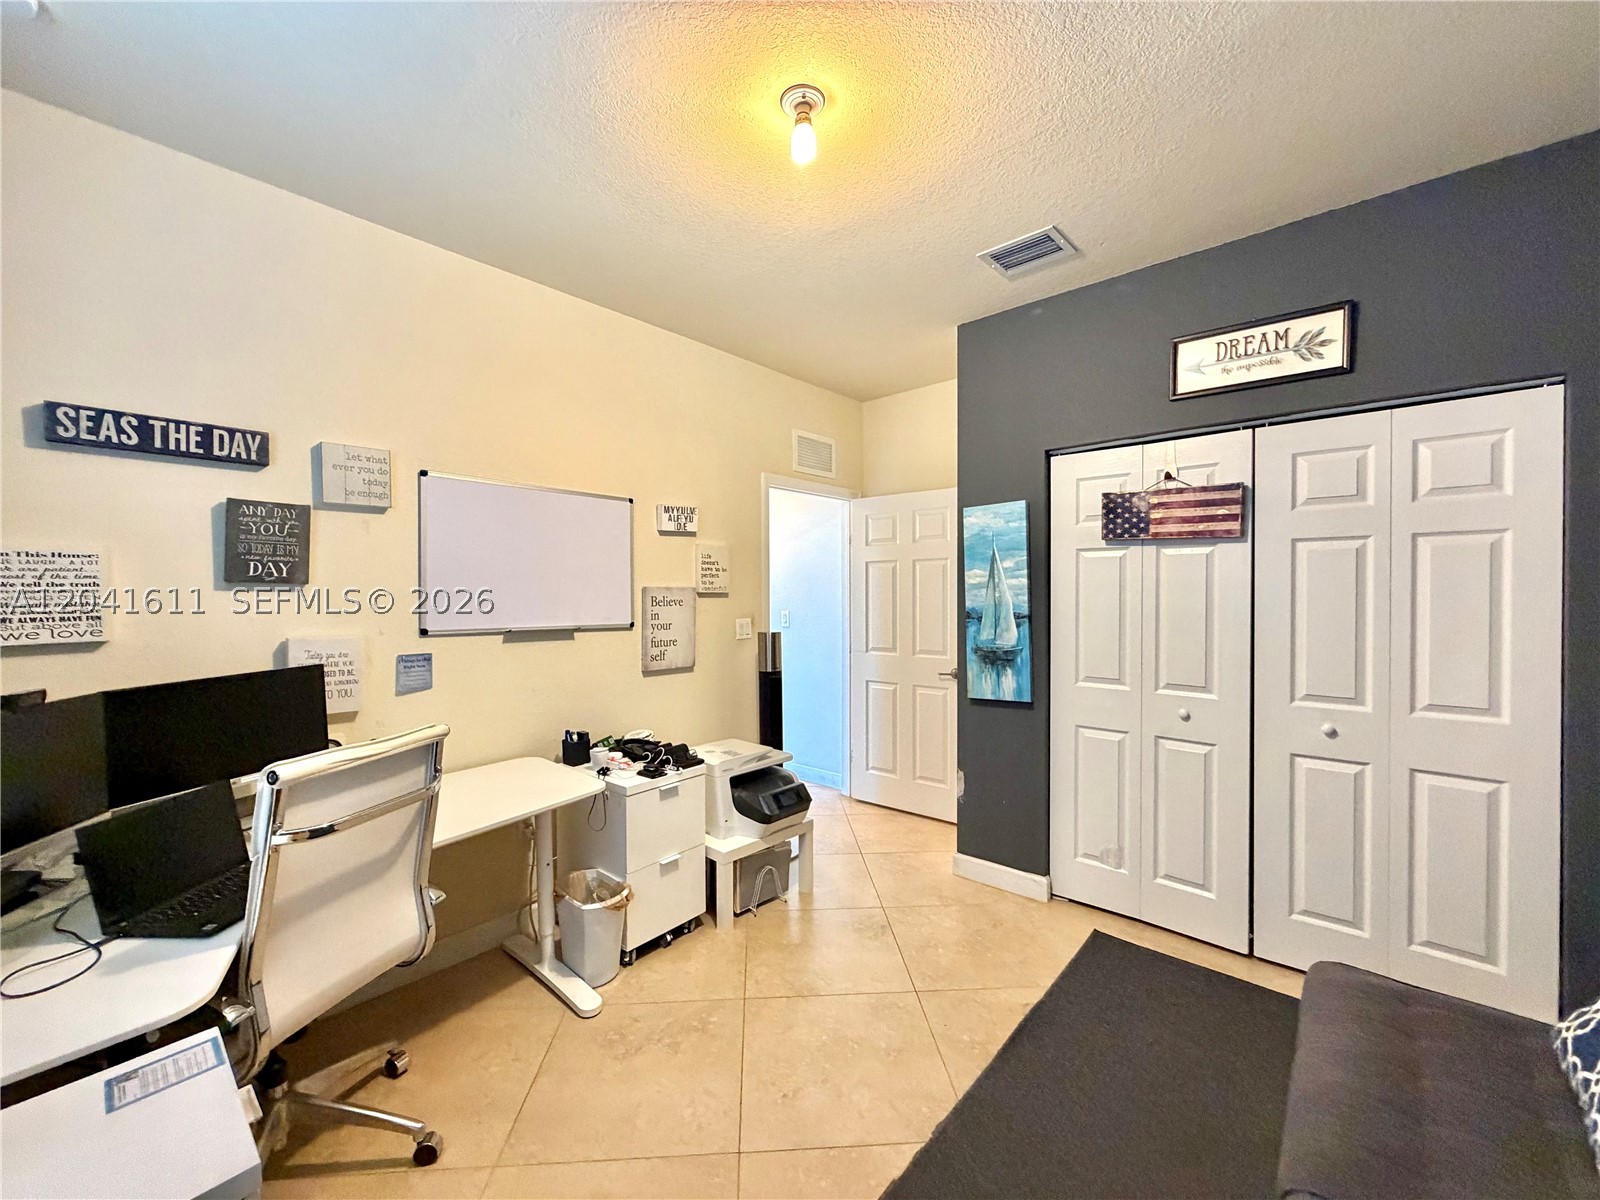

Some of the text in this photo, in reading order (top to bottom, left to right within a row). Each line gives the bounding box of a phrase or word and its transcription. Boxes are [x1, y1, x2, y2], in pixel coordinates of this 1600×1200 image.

[1215, 327, 1291, 362] DREAM
[55, 406, 262, 461] SEAS THE DAY
[345, 452, 388, 464] let what
[332, 463, 389, 475] ever you do
[362, 478, 388, 489] today
[344, 487, 389, 500] be enough
[239, 504, 298, 518] ANY DAY
[248, 522, 290, 536] YOU
[251, 543, 274, 554] TODAY
[286, 545, 299, 555] MY
[246, 561, 292, 577] DAY
[650, 595, 684, 607] Believe
[650, 609, 660, 620] in
[32, 622, 80, 630] above
[650, 622, 672, 634] your
[0, 628, 104, 641] we love
[650, 636, 677, 648] future
[649, 649, 667, 662] self
